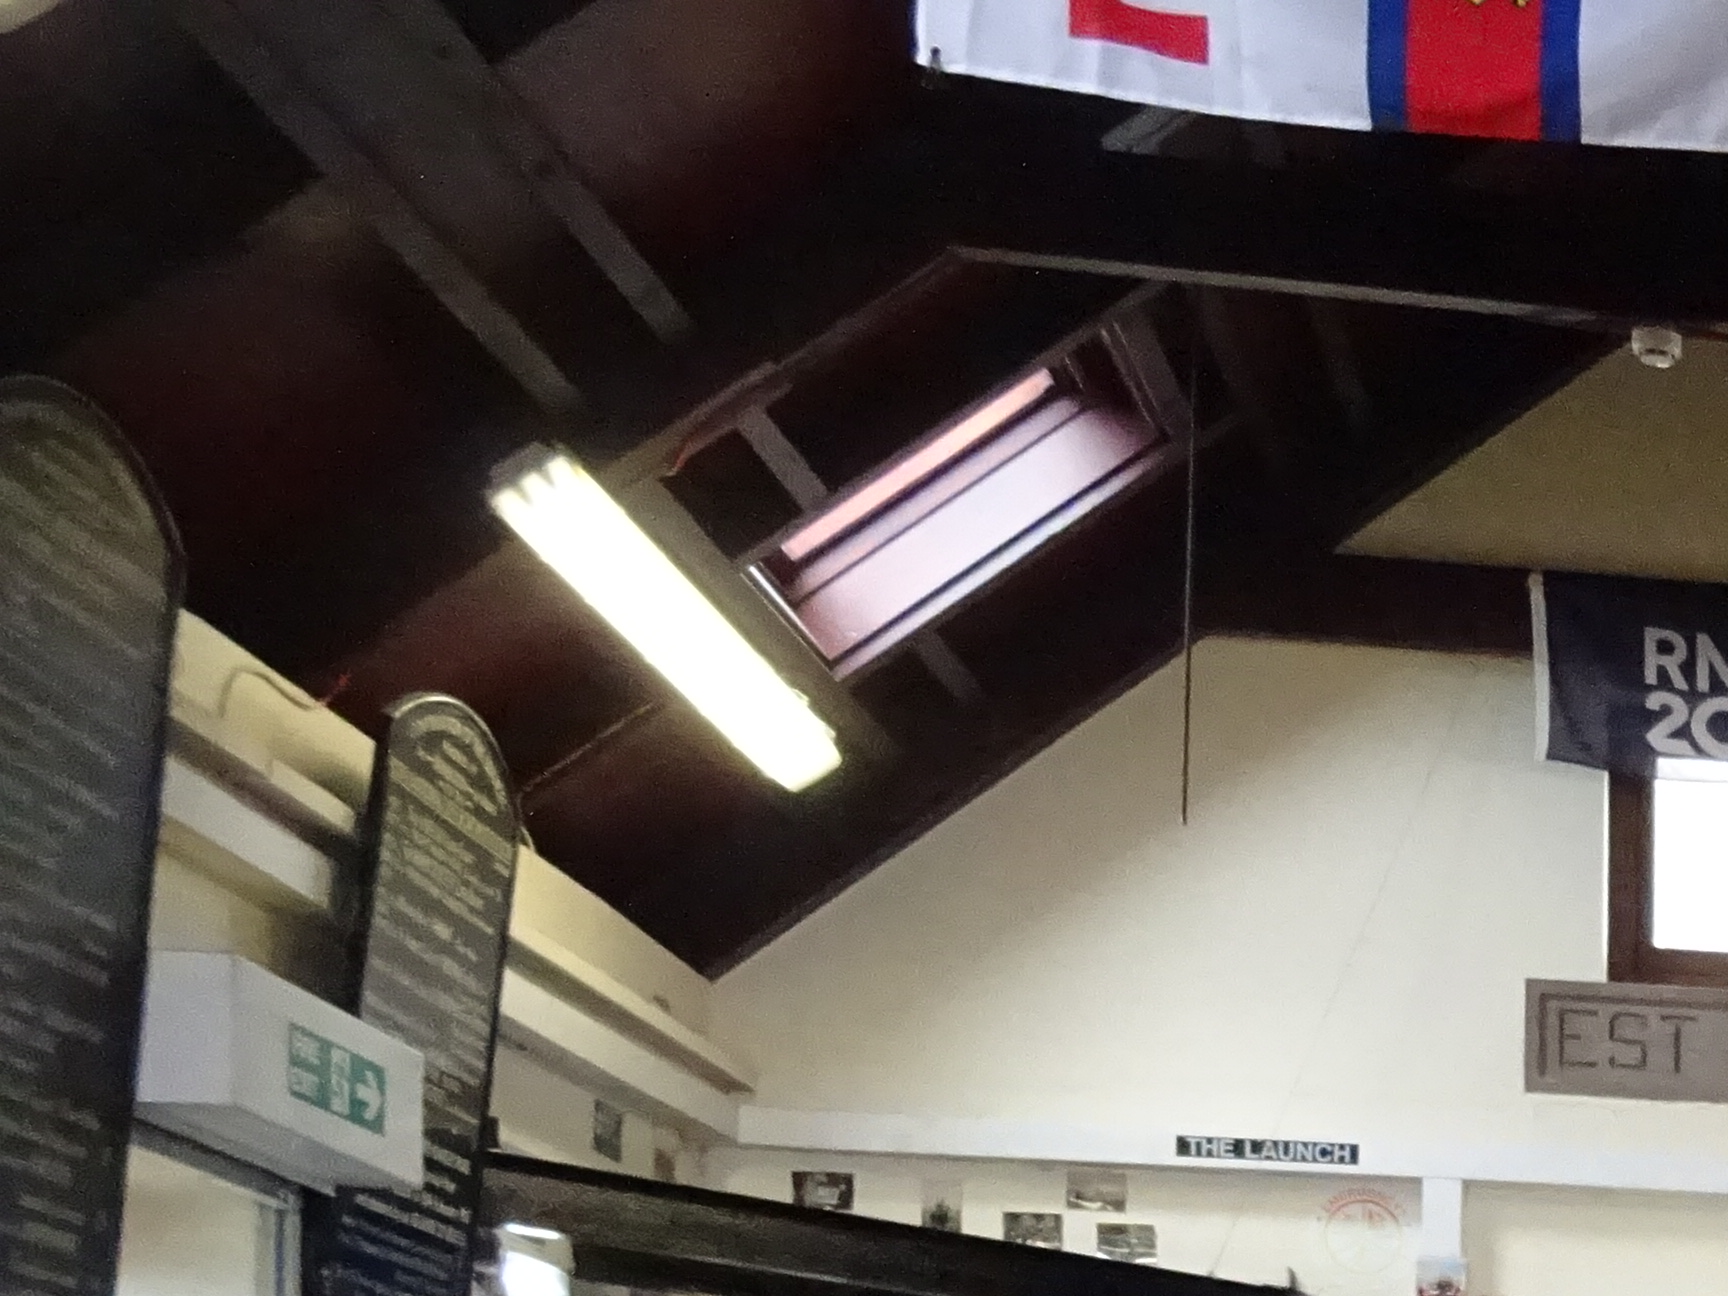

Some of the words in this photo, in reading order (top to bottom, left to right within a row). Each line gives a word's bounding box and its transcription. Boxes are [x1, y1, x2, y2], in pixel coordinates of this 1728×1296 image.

[1557, 1008, 1697, 1075] EST
[1186, 1136, 1236, 1159] THE
[1245, 1138, 1351, 1164] LAUNCH
